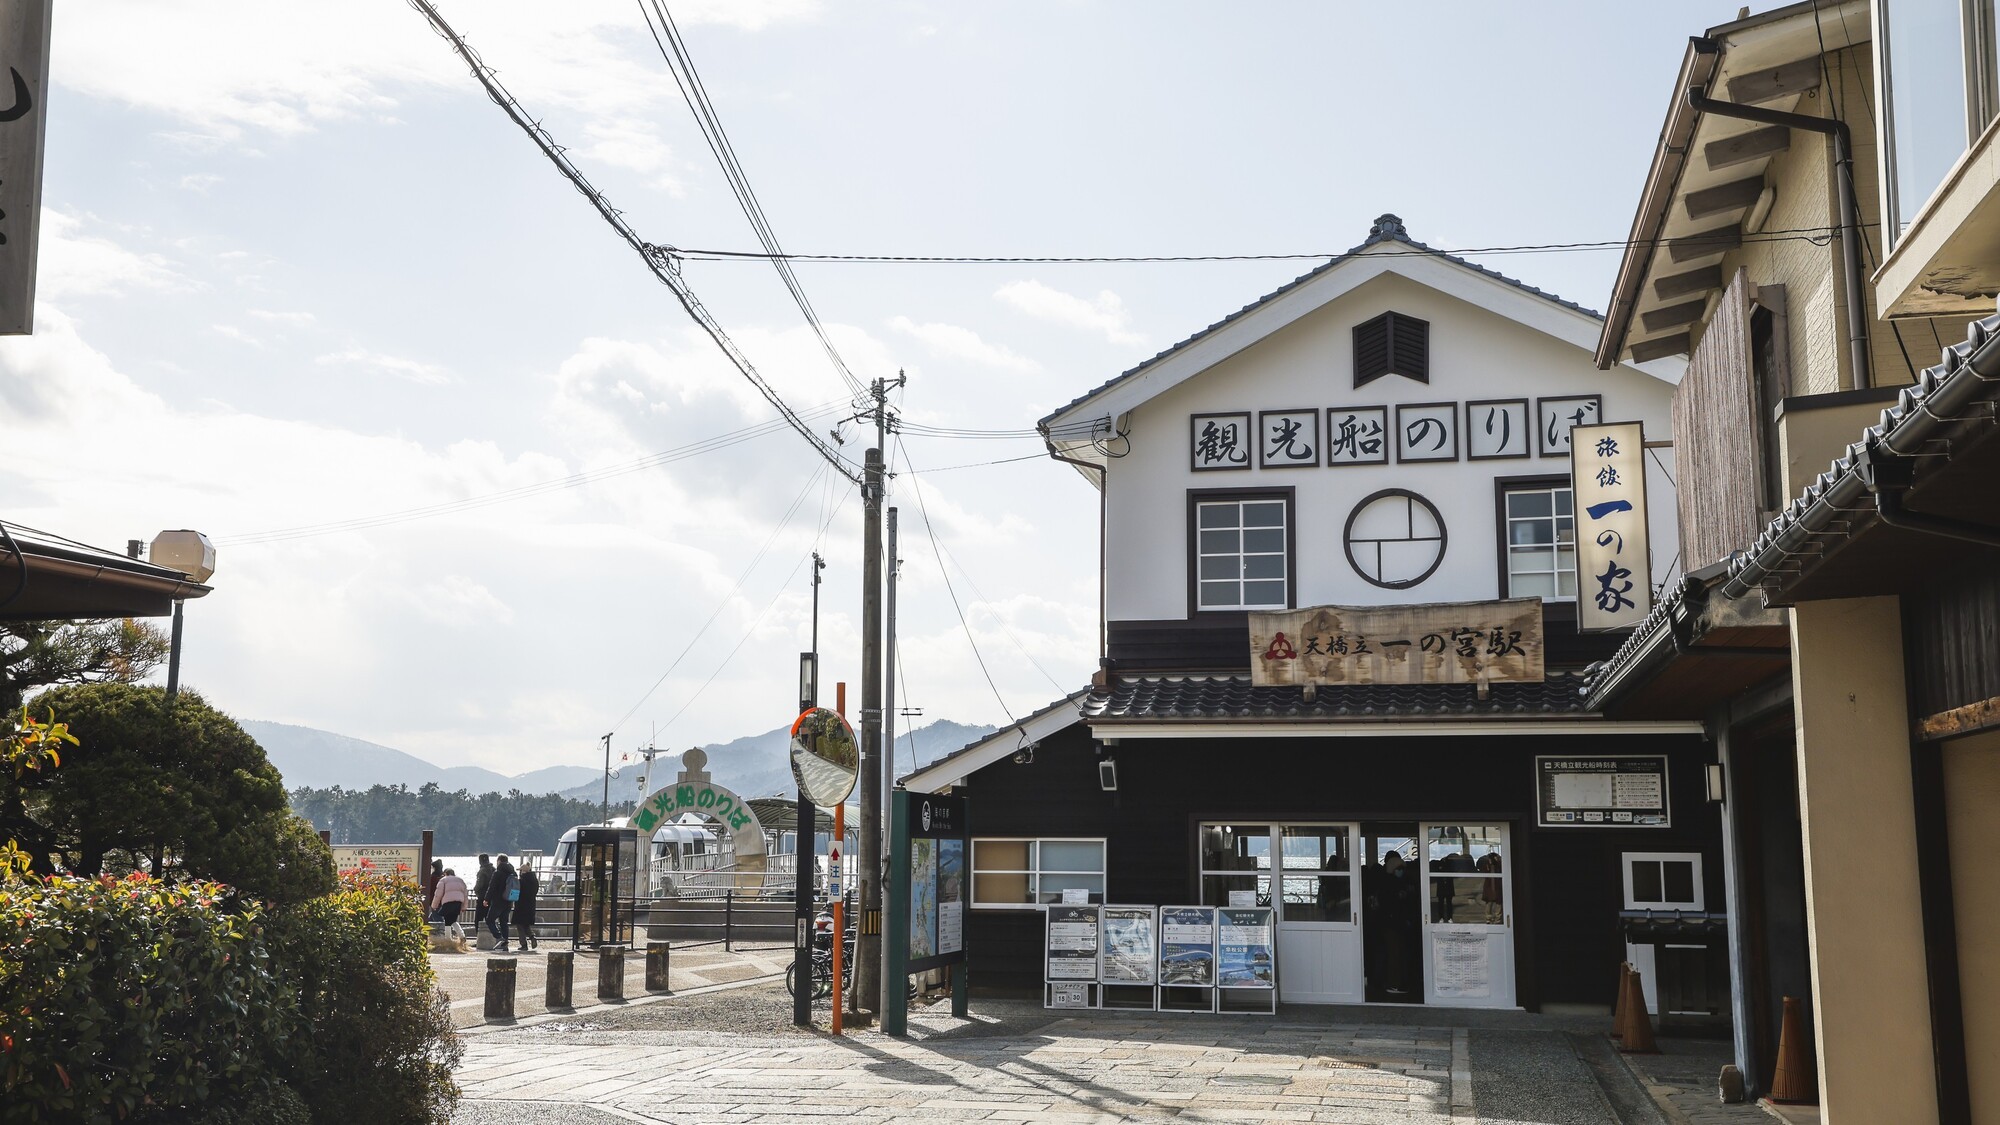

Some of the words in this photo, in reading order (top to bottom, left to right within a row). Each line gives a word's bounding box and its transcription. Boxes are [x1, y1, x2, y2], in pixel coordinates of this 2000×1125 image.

[1195, 401, 1597, 465] 観光船のりば
[829, 865, 840, 896] 注意
